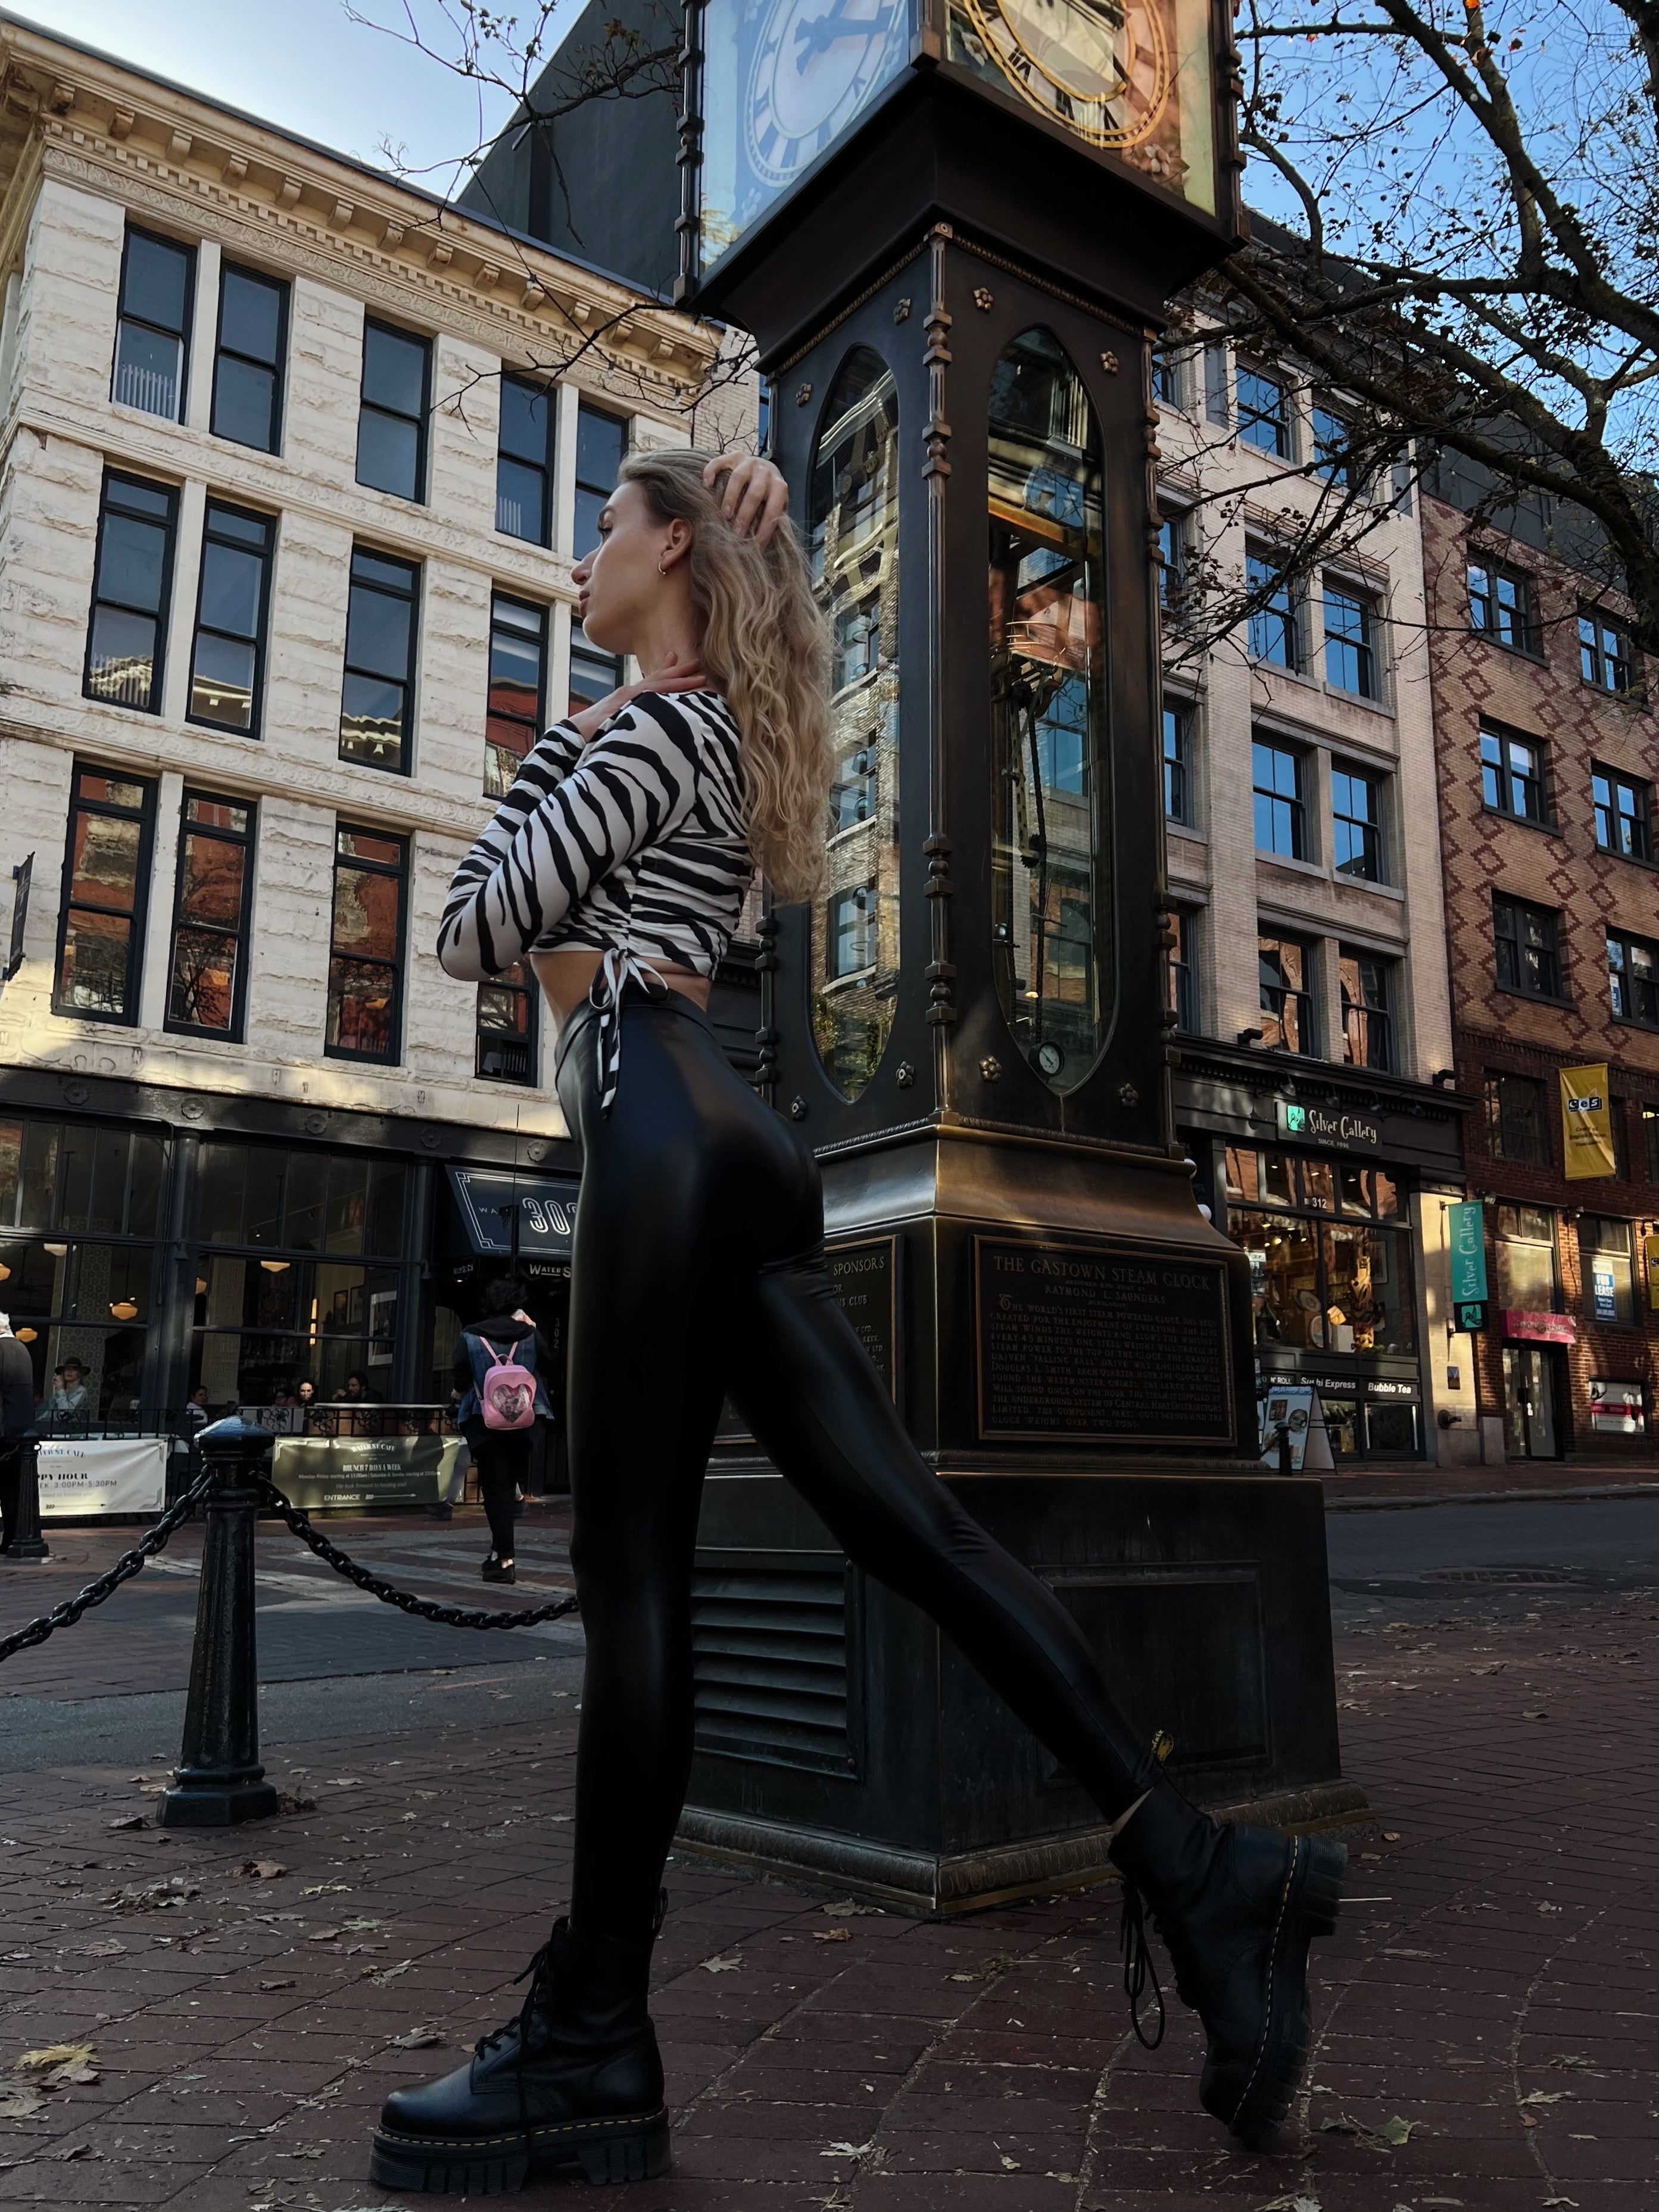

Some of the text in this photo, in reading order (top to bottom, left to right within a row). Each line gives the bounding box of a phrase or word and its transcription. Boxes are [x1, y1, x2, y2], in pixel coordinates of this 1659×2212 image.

[1308, 1110, 1377, 1144] Silver Gallery
[1312, 1197, 1327, 1209] 312
[1459, 1206, 1479, 1297] Silver Gallery
[529, 1264, 561, 1276] WATER
[833, 1256, 885, 1276] SPONSORS
[993, 1255, 1210, 1290] THE GASTOWN STEAM CLOCK
[1596, 1274, 1610, 1286] FOR
[849, 1294, 868, 1306] CLUB
[1044, 1284, 1165, 1304] RAYMOND L. SAUNDERS
[1594, 1285, 1614, 1297] LEASE
[990, 1312, 1029, 1322] CREATED
[1033, 1315, 1050, 1324] FOR
[1053, 1316, 1069, 1325] THE
[1071, 1318, 1119, 1329] ENJOYMENT
[1122, 1322, 1131, 1330] OF
[1182, 1327, 1197, 1335] THE
[1027, 1303, 1062, 1315] WORLD'S
[1065, 1307, 1086, 1316] FIRST
[1088, 1309, 1113, 1319] STEAM
[1116, 1312, 1153, 1322] POWERED
[1155, 1315, 1180, 1324] CLOCK
[1183, 1317, 1196, 1325] HAS
[990, 1321, 1018, 1331] STEAM
[1022, 1324, 1052, 1334] WINDS
[1055, 1326, 1071, 1335] THE
[1075, 1328, 1111, 1338] WEIGHTS
[1114, 1331, 1131, 1339] AND
[1134, 1332, 1161, 1341] BLOWS
[1162, 1334, 1178, 1343] THE
[990, 1331, 1018, 1341] EVERY
[1036, 1335, 1072, 1345] MINUTES
[1076, 1338, 1093, 1346] ONE
[1097, 1339, 1120, 1348] STEEL
[1122, 1341, 1155, 1350] WEIGHT
[1156, 1343, 1176, 1352] WILL
[1177, 1345, 1206, 1354] TRAVEL
[990, 1341, 1018, 1351] STEAM
[1022, 1343, 1052, 1353] POWER
[1055, 1346, 1065, 1354] TO
[1067, 1346, 1083, 1355] THE
[1086, 1348, 1101, 1356] TOP
[1117, 1350, 1133, 1358] THE
[1167, 1353, 1182, 1362] THE
[1186, 1355, 1219, 1364] GRAVITY
[991, 1352, 1025, 1362] DRIVEN
[1101, 1358, 1127, 1368] DRIVE
[1133, 1361, 1150, 1369] WAS
[1156, 1362, 1206, 1372] ENGINEERED
[991, 1361, 1031, 1372] DOUGLAS
[1077, 1367, 1097, 1376] EACH
[1099, 1368, 1134, 1378] QUARTER
[1137, 1370, 1157, 1379] HOUR
[1159, 1371, 1172, 1380] THE
[1175, 1372, 1200, 1381] CLOCK
[1202, 1374, 1220, 1383] WILL
[991, 1372, 1021, 1382] SOUND
[1025, 1374, 1042, 1383] THE
[1046, 1375, 1105, 1386] WESTMINSTER
[1143, 1381, 1158, 1389] THE
[1160, 1381, 1184, 1390] LARGE
[1189, 1383, 1221, 1392] WHISTLE
[1325, 1380, 1356, 1389] Express
[1368, 1383, 1412, 1394] Bubble Tea
[992, 1383, 1013, 1393] WILL
[1016, 1384, 1044, 1394] SOUND
[1047, 1386, 1070, 1395] ONCE
[1072, 1387, 1085, 1396] ON
[1087, 1388, 1102, 1396] THE
[1128, 1390, 1144, 1399] THE
[1145, 1391, 1168, 1400] STEAM
[1177, 1392, 1210, 1402] SUPPLIED
[1212, 1394, 1220, 1402] BY
[992, 1394, 1222, 1412] THE UNDERGROUND SYSTEM OF CENTRAL HEAT DISTRIBUTORS
[991, 1415, 1021, 1424] CLOCK
[1027, 1417, 1060, 1425] WEIGHS
[1065, 1418, 1088, 1427] OVER
[1093, 1419, 1112, 1427] TWO
[1036, 1406, 1053, 1415] THE
[1057, 1408, 1105, 1417] COMPONENT
[1111, 1409, 1134, 1418] PARTS
[1139, 1411, 1158, 1419] COST
[1190, 1412, 1206, 1421] AND
